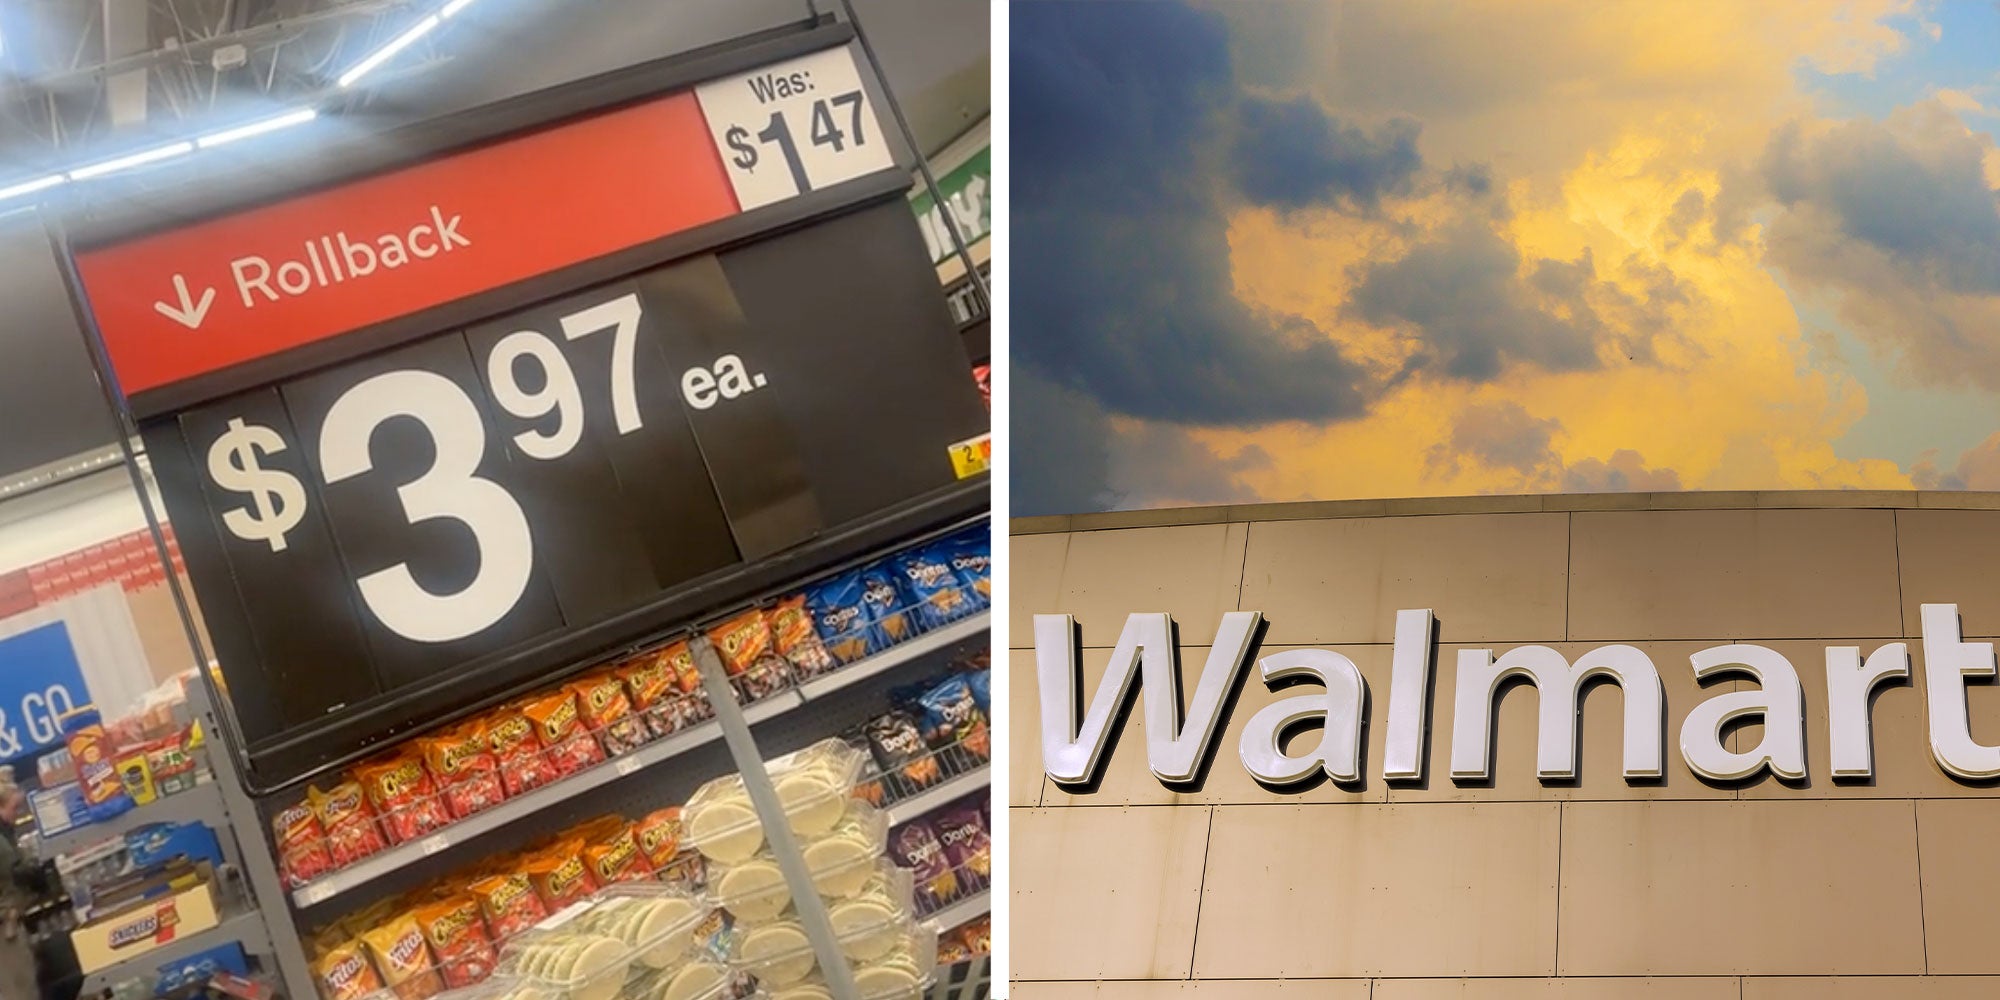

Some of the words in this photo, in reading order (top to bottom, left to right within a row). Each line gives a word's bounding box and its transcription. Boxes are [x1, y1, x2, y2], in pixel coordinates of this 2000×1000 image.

[748, 71, 815, 104] Was:
[231, 206, 471, 308] Rollback
[681, 353, 767, 410] ea.
[1032, 603, 2000, 786] Walmart
[111, 917, 158, 943] SNICKERS
